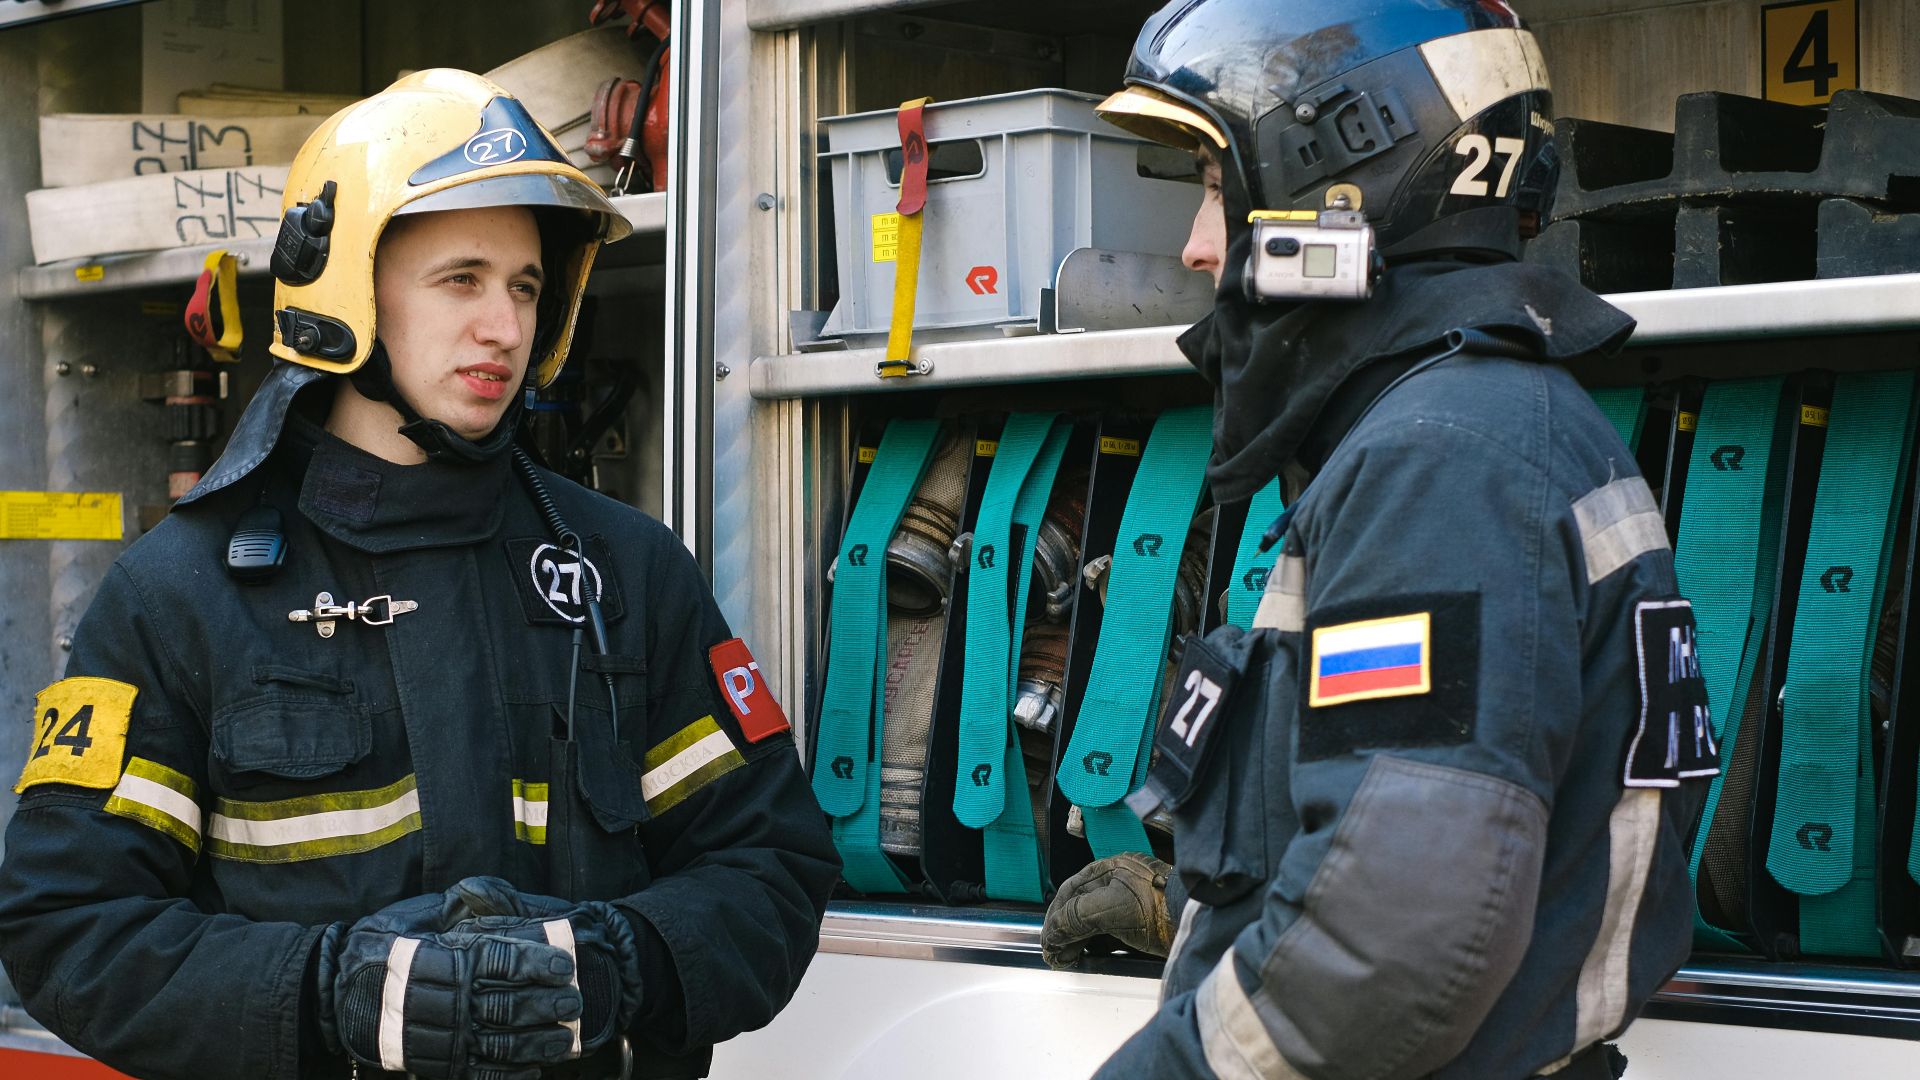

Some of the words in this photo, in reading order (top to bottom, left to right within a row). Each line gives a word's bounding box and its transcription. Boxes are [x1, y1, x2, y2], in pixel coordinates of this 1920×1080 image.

[1783, 10, 1838, 97] 4
[472, 131, 513, 162] 27
[1450, 134, 1525, 198] 27
[541, 558, 581, 605] 27
[31, 704, 94, 762] 24
[1170, 669, 1223, 748] 27
